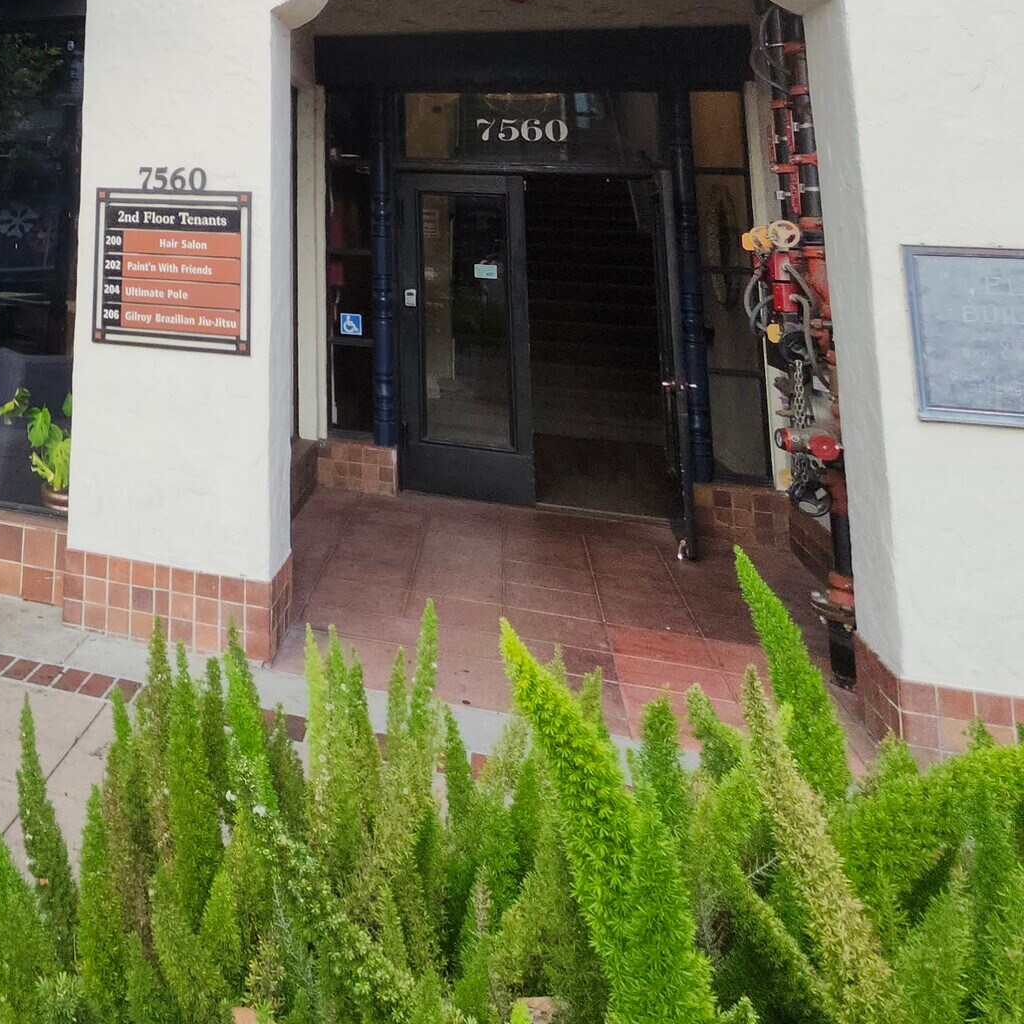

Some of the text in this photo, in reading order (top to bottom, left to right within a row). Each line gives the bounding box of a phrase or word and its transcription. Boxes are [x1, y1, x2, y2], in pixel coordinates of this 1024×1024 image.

[476, 117, 569, 143] 7560
[139, 166, 208, 191] 7560
[117, 210, 227, 227] 2nd Floor Tenants
[105, 235, 208, 250] 200 Hair Salon
[104, 259, 213, 276] 202 Paint'n With Friends
[103, 283, 189, 300] 204 Ultimate Pole
[103, 308, 237, 330] 206 Gilroy Brazilian Jiu-Jitsu
